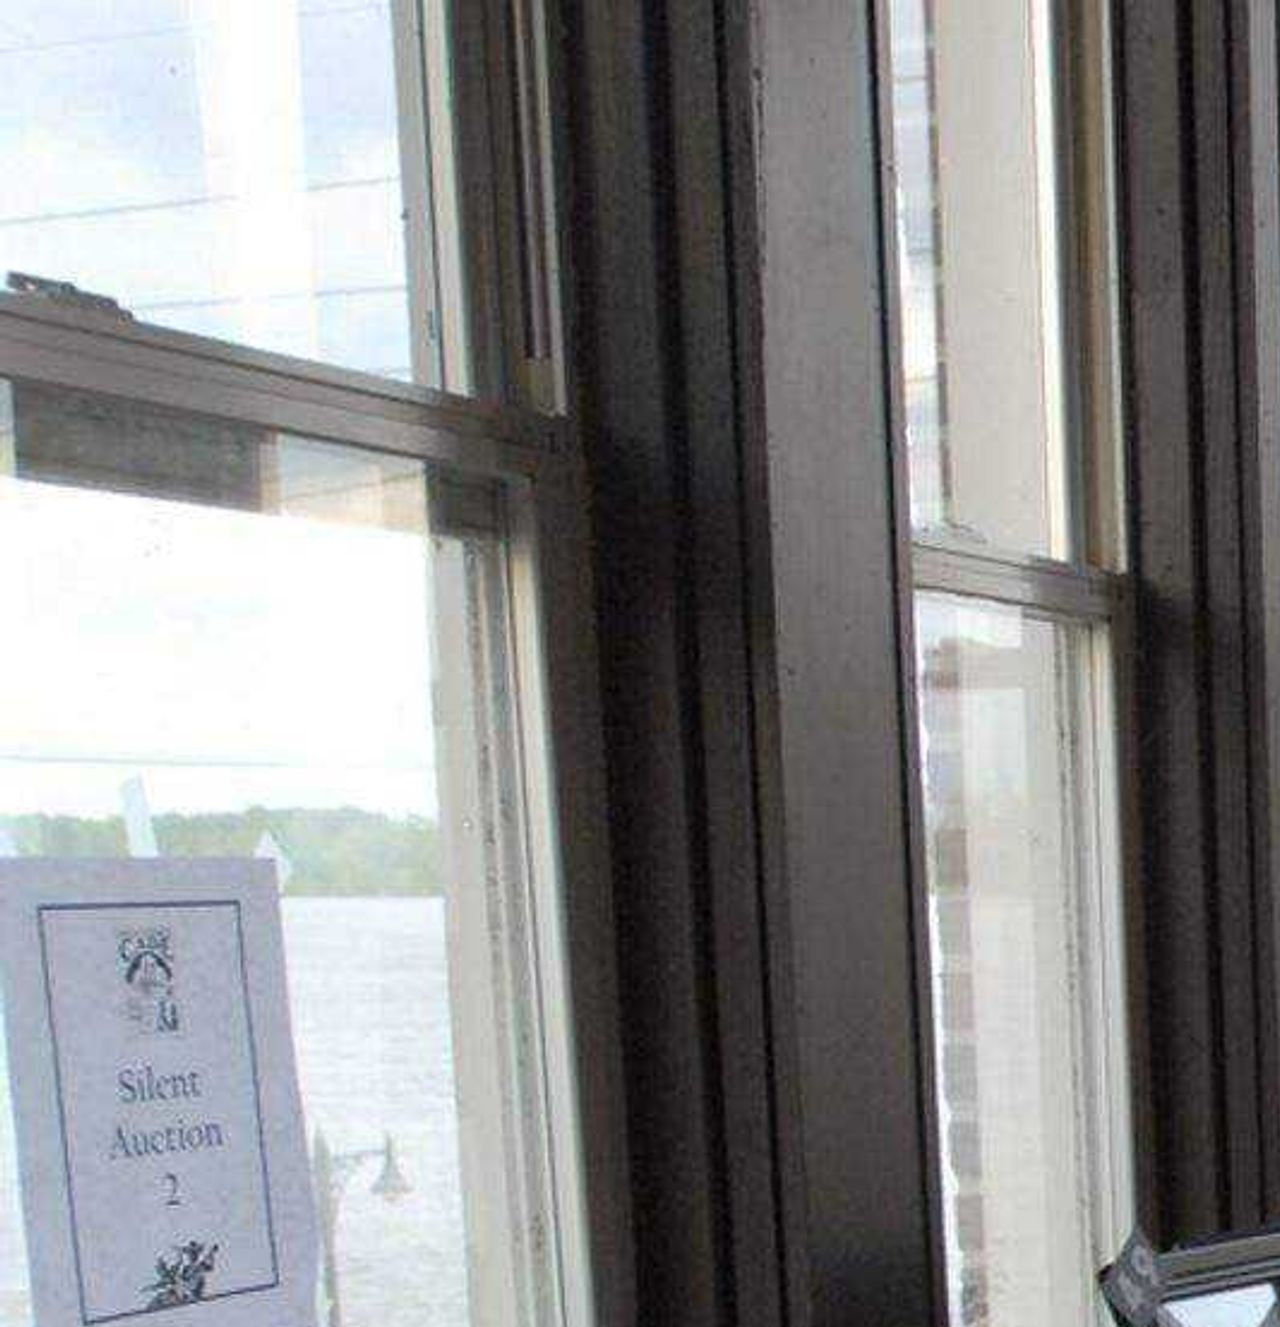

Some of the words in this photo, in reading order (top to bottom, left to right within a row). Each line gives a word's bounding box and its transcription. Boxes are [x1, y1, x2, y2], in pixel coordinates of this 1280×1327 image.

[118, 1066, 202, 1103] Silent
[112, 1119, 223, 1160] Auction
[163, 1172, 182, 1207] 2
